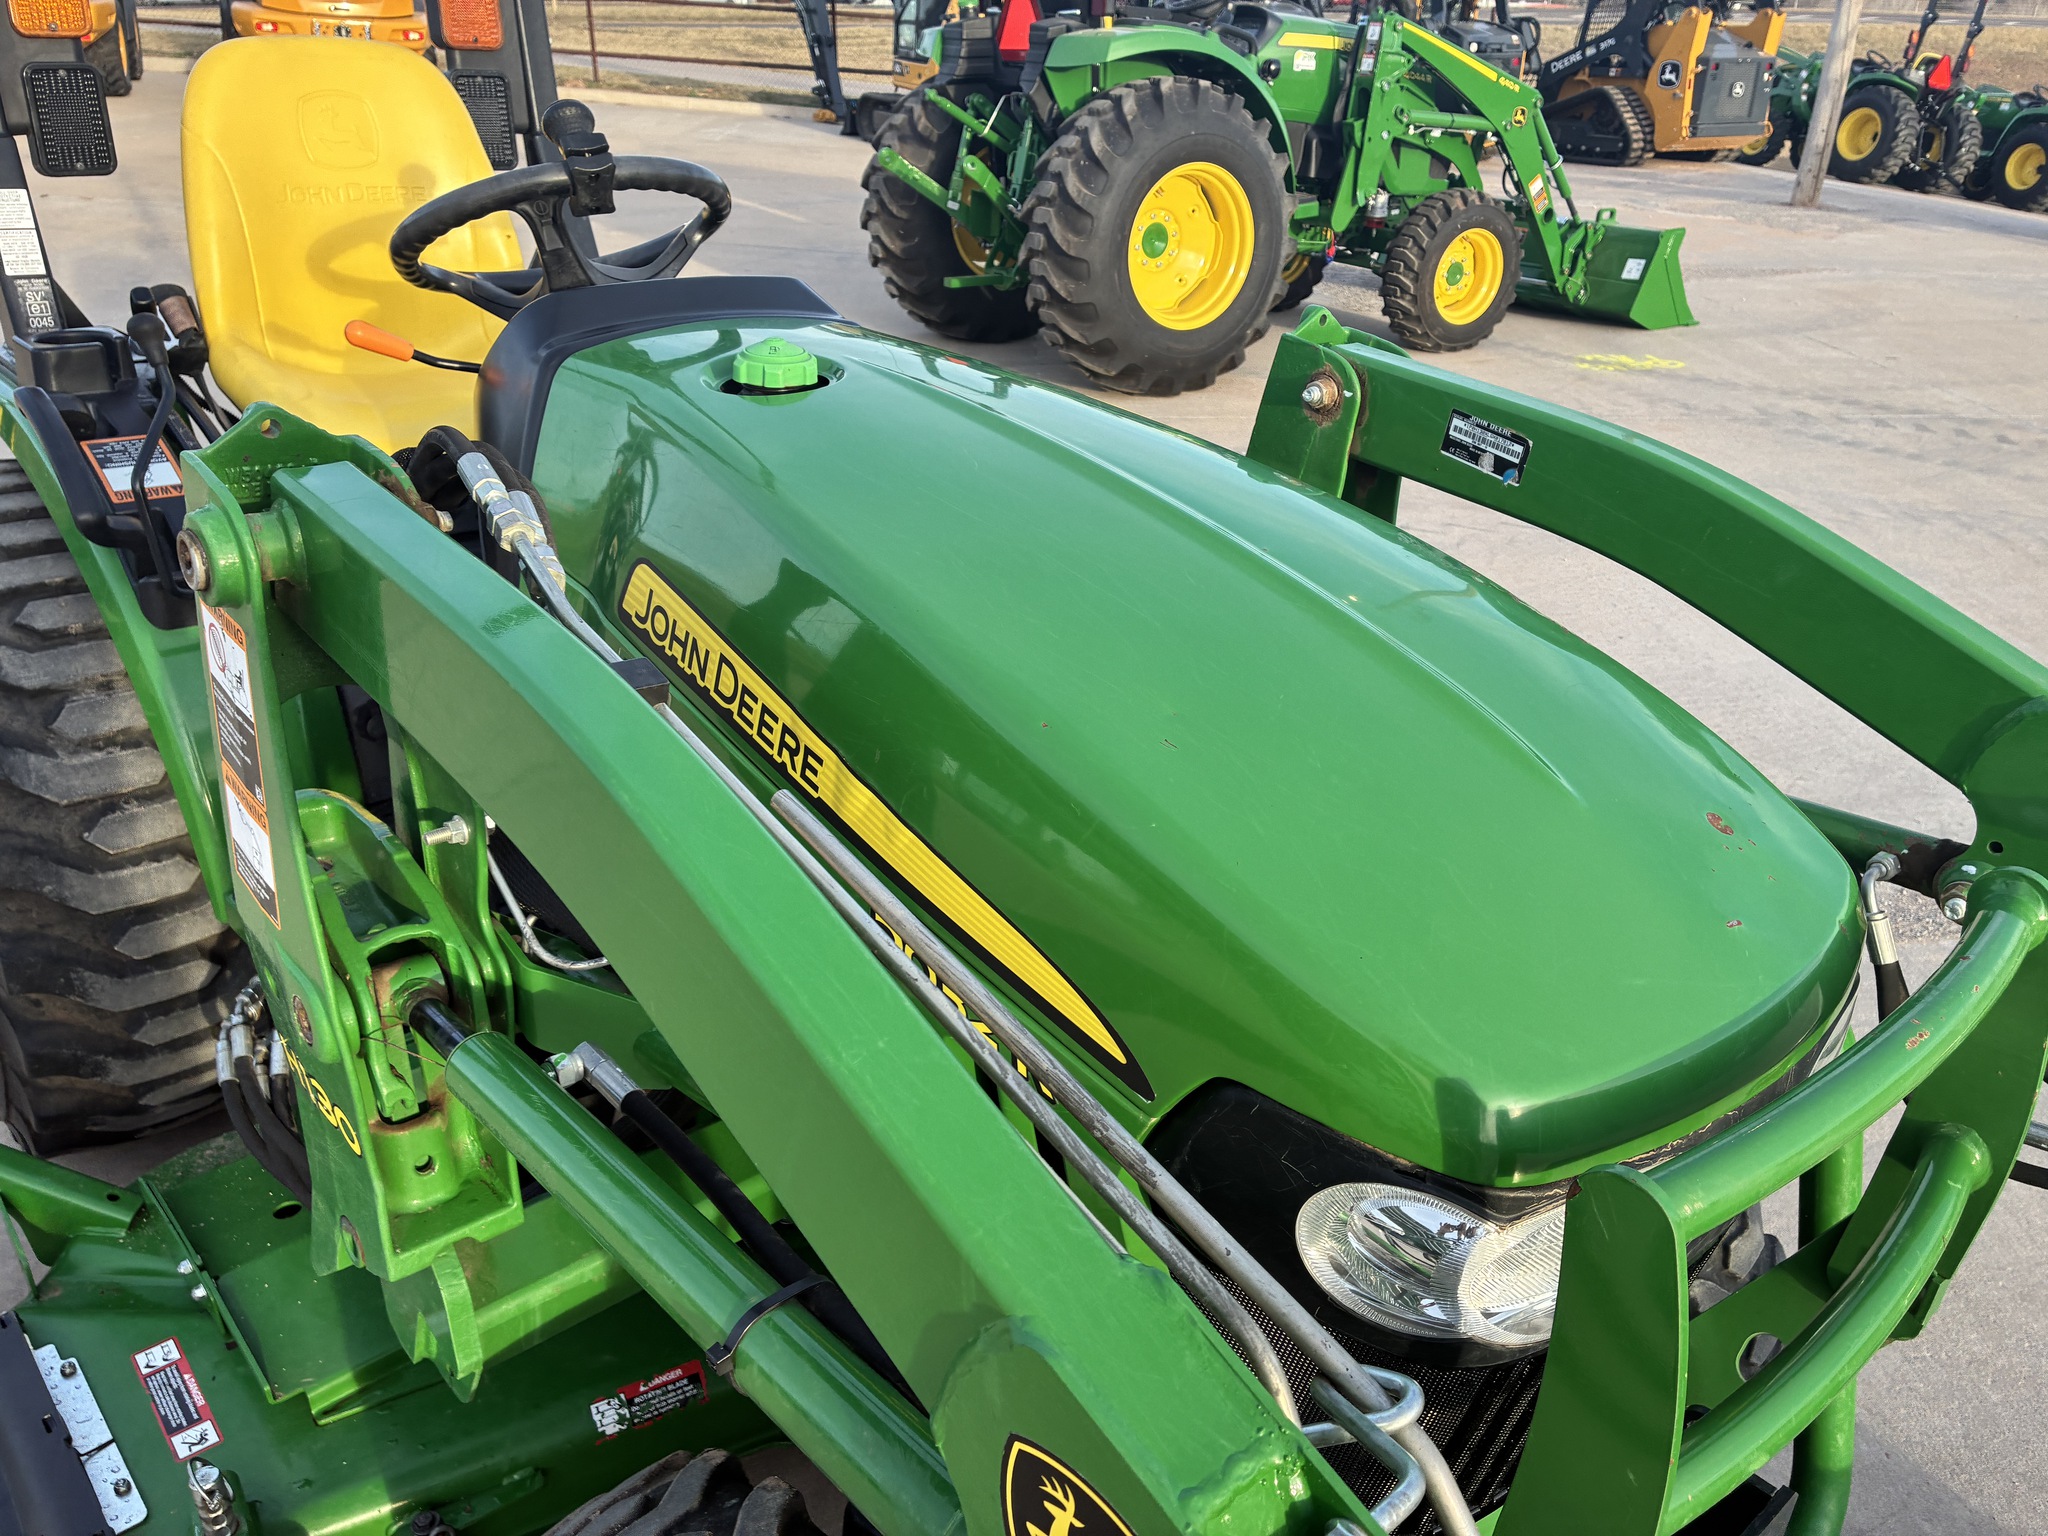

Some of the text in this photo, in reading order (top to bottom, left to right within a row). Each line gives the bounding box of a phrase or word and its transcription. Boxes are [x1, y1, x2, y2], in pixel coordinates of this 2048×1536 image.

[1550, 49, 1583, 74] DEERE
[277, 182, 428, 205] JOHN DEERE
[29, 316, 55, 328] 0045
[1470, 415, 1512, 437] JOHN DEERE
[114, 485, 172, 501] WARNG
[634, 588, 825, 796] JOHN DEERE
[230, 775, 267, 830] WARNING
[187, 1376, 206, 1408] DANGER
